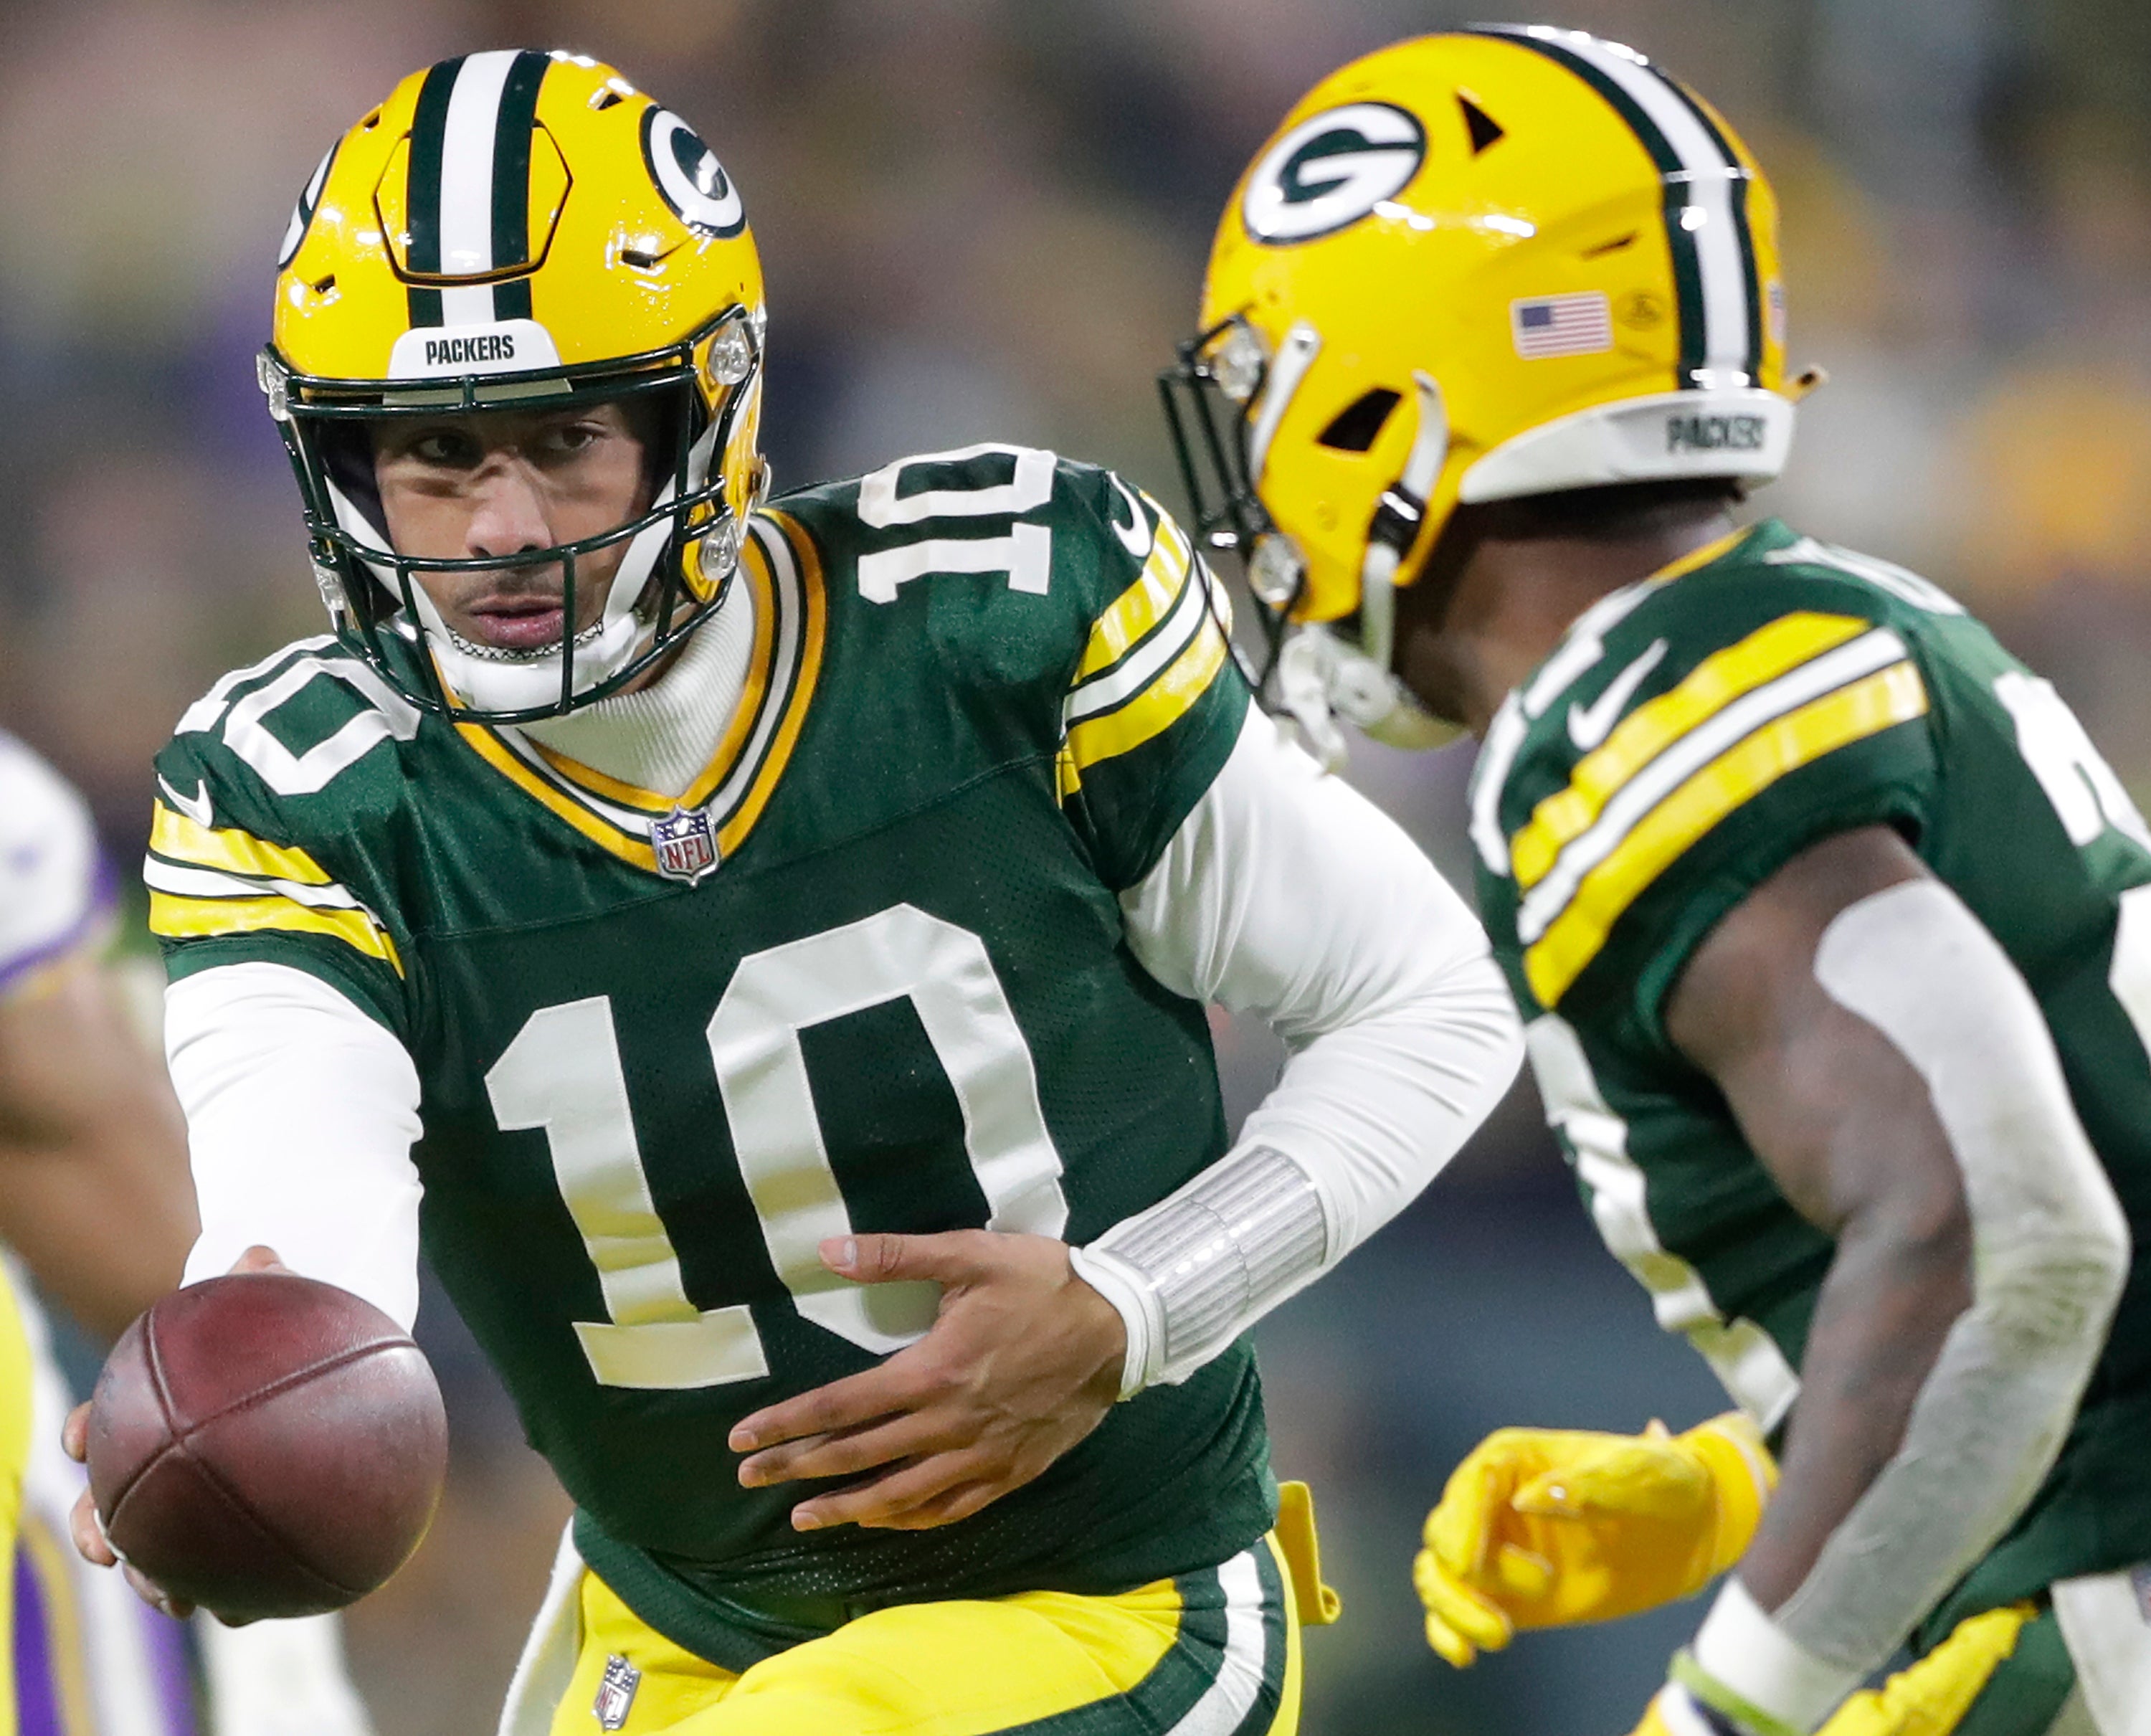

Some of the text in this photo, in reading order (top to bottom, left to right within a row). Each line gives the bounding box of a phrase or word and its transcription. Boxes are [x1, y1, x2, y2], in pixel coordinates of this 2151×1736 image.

[1243, 102, 1425, 244] G
[425, 334, 515, 366] PACKERS
[858, 442, 1057, 604] 10
[174, 635, 422, 795] 10
[664, 836, 711, 870] NFL
[485, 903, 1068, 1389] 10
